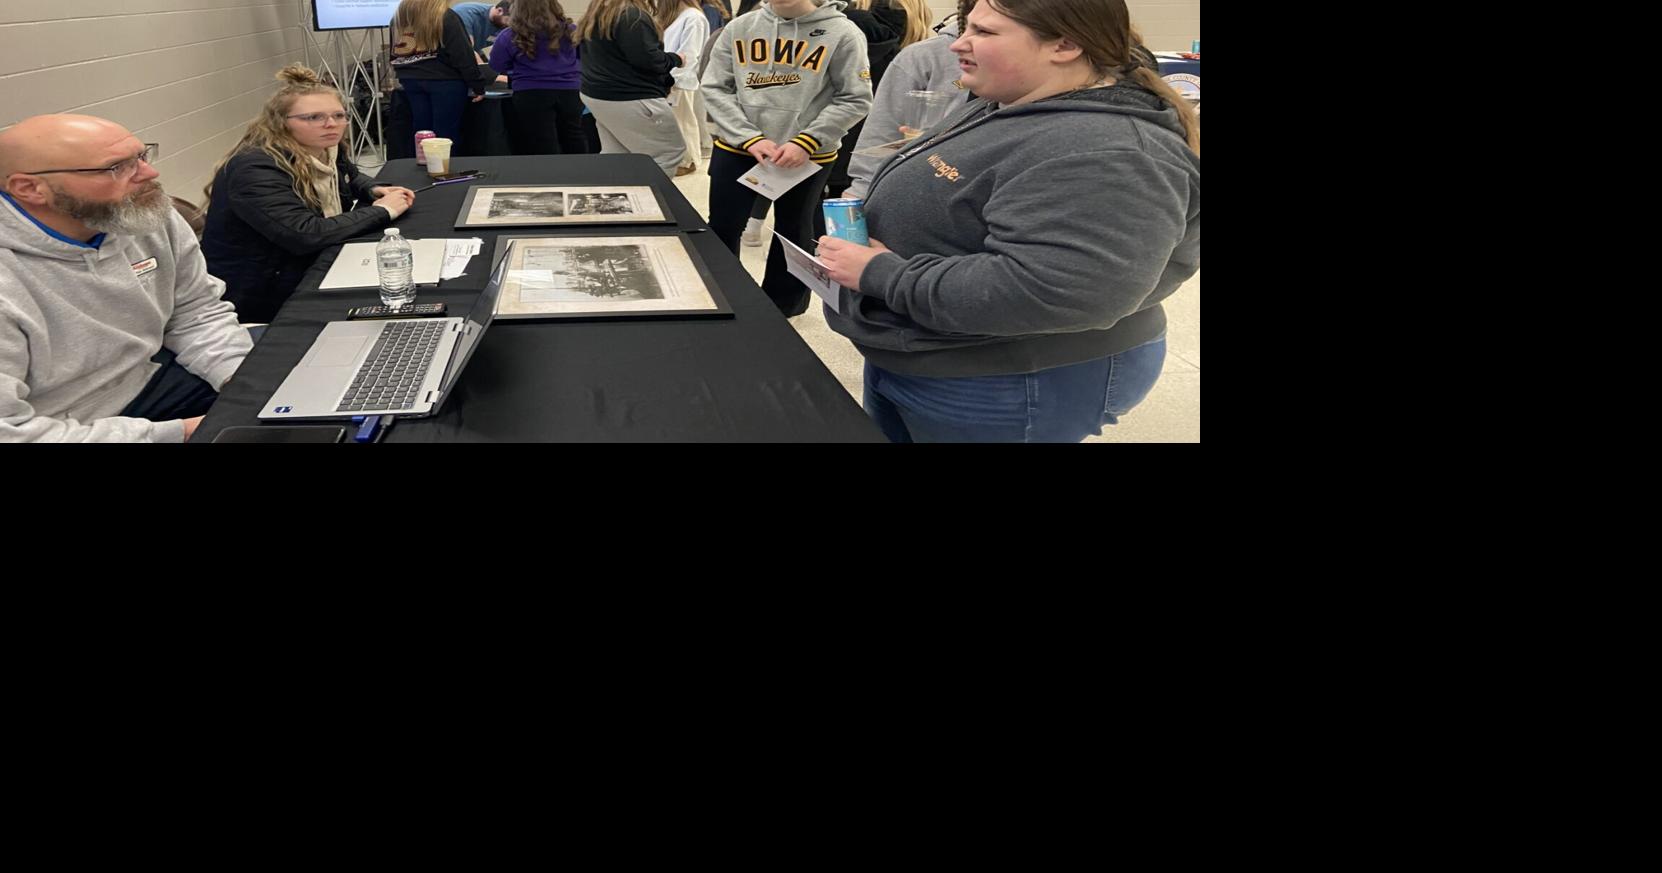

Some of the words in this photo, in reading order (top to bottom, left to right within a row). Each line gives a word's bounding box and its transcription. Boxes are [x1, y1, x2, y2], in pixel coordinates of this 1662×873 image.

[735, 37, 827, 73] IOWA
[745, 71, 801, 86] Hawkeyes
[927, 152, 965, 182] Wrangler
